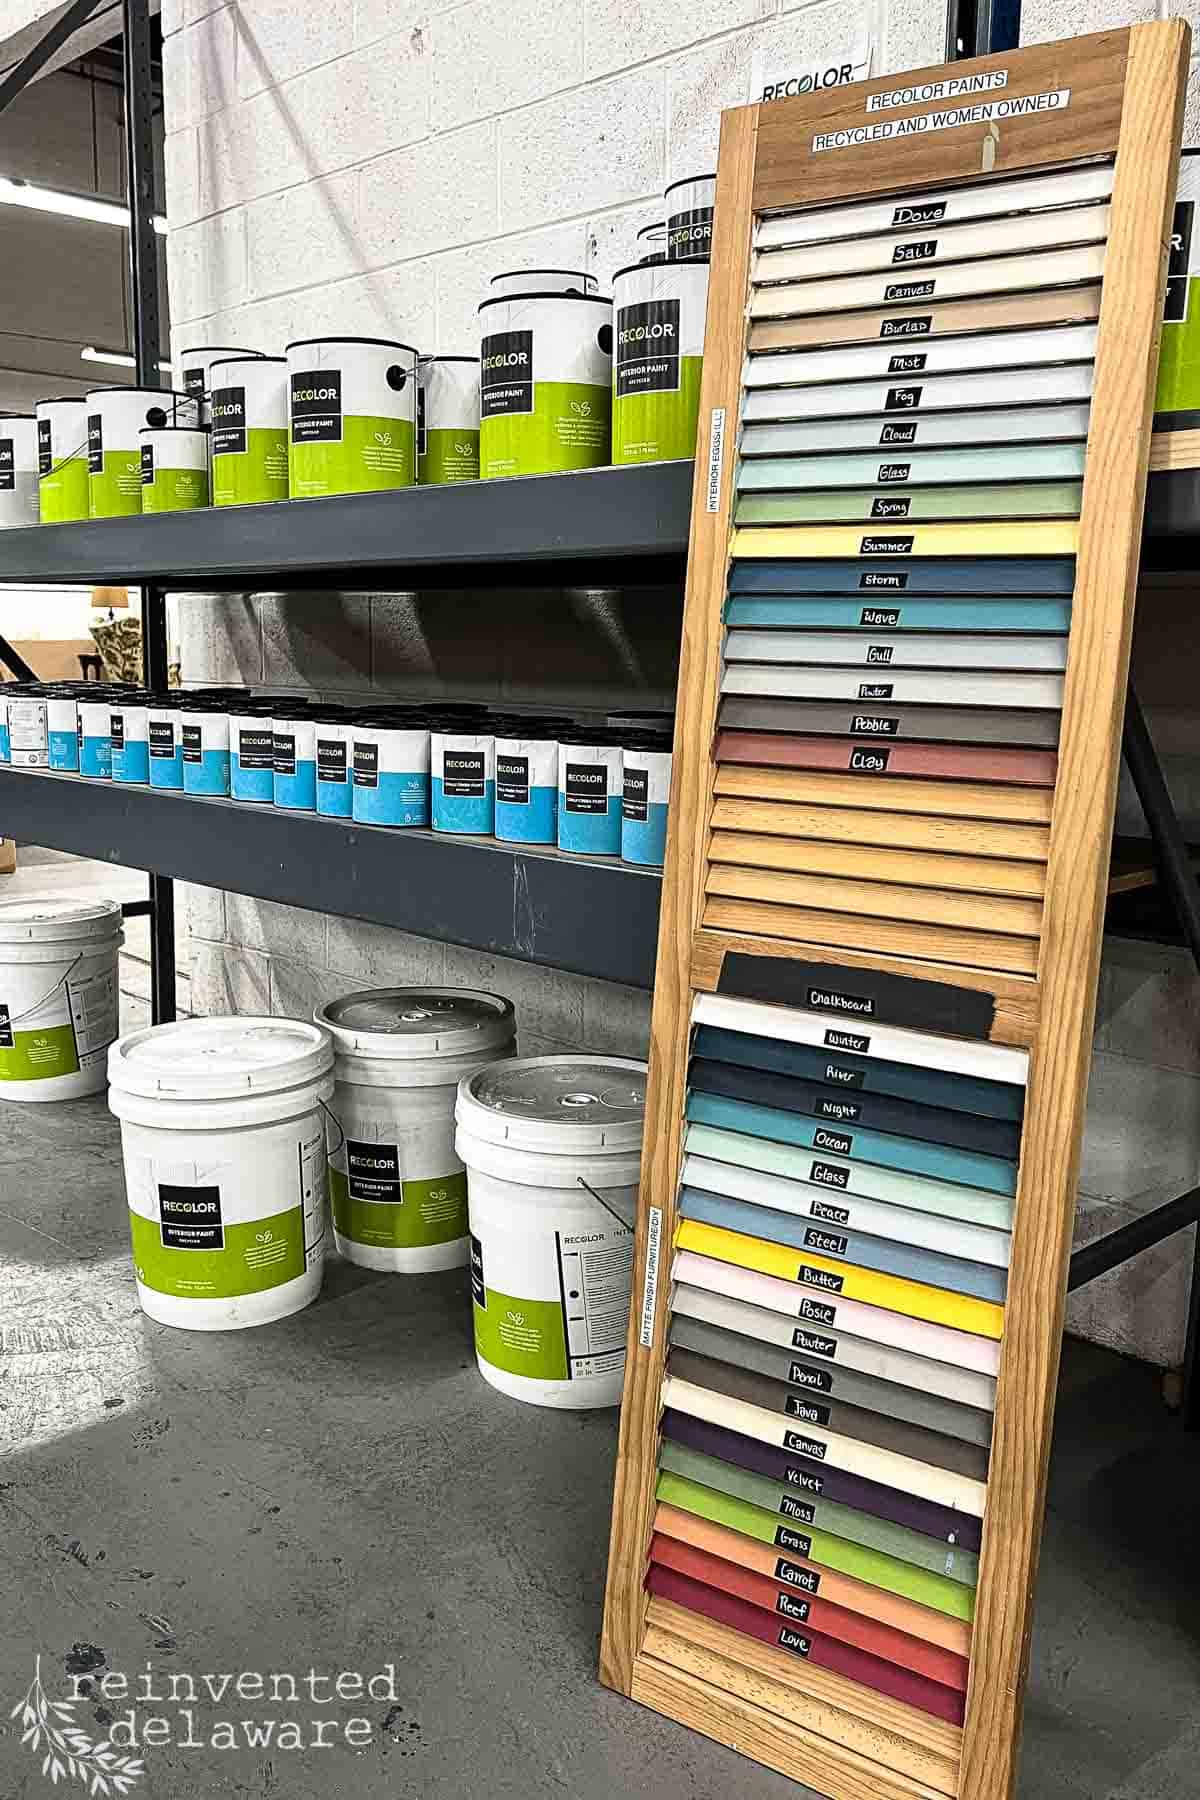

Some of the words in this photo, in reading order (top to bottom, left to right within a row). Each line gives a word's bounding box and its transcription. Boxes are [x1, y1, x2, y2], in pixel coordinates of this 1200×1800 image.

[871, 83, 943, 109] RECOLOR
[948, 71, 1006, 94] PAINTS
[815, 123, 892, 149] RECYCLED
[896, 116, 927, 134] AND
[932, 103, 992, 127] WOMEN
[997, 93, 1060, 117] OWNED
[893, 207, 943, 224] Dove
[895, 242, 932, 260] Sail
[886, 283, 933, 299] Canvas
[883, 320, 928, 335] Burlap
[895, 389, 915, 407] Fog
[882, 426, 914, 441] Cloud
[879, 465, 908, 480] Glass
[709, 464, 719, 511] INTERIOR
[875, 500, 907, 516] Spring
[862, 538, 911, 552] Summer
[865, 574, 900, 587] Storm
[864, 611, 897, 625] Wave
[869, 647, 891, 662] Gull
[855, 717, 891, 731] Pebble
[852, 752, 884, 770] Clay
[810, 991, 873, 1012] Chalkboard
[828, 1032, 865, 1049] Winter
[826, 1064, 856, 1081] River
[823, 1102, 857, 1118] Night
[815, 1132, 849, 1151] Ocean
[814, 1164, 846, 1185] Glass
[812, 1201, 848, 1224] Peace
[807, 1231, 847, 1254] Steel
[803, 1267, 841, 1288] Butter
[645, 1281, 655, 1311] FINISH
[801, 1300, 833, 1324] Posie
[642, 1311, 652, 1344] MATTE
[793, 1399, 818, 1420] Java
[788, 1434, 825, 1458] Canvas
[786, 1469, 823, 1492] Velvet
[783, 1498, 812, 1521] Moss
[780, 1529, 808, 1551] Grass
[780, 1563, 815, 1590] Carrot
[779, 1595, 808, 1617] Reef
[781, 1629, 809, 1652] Love
